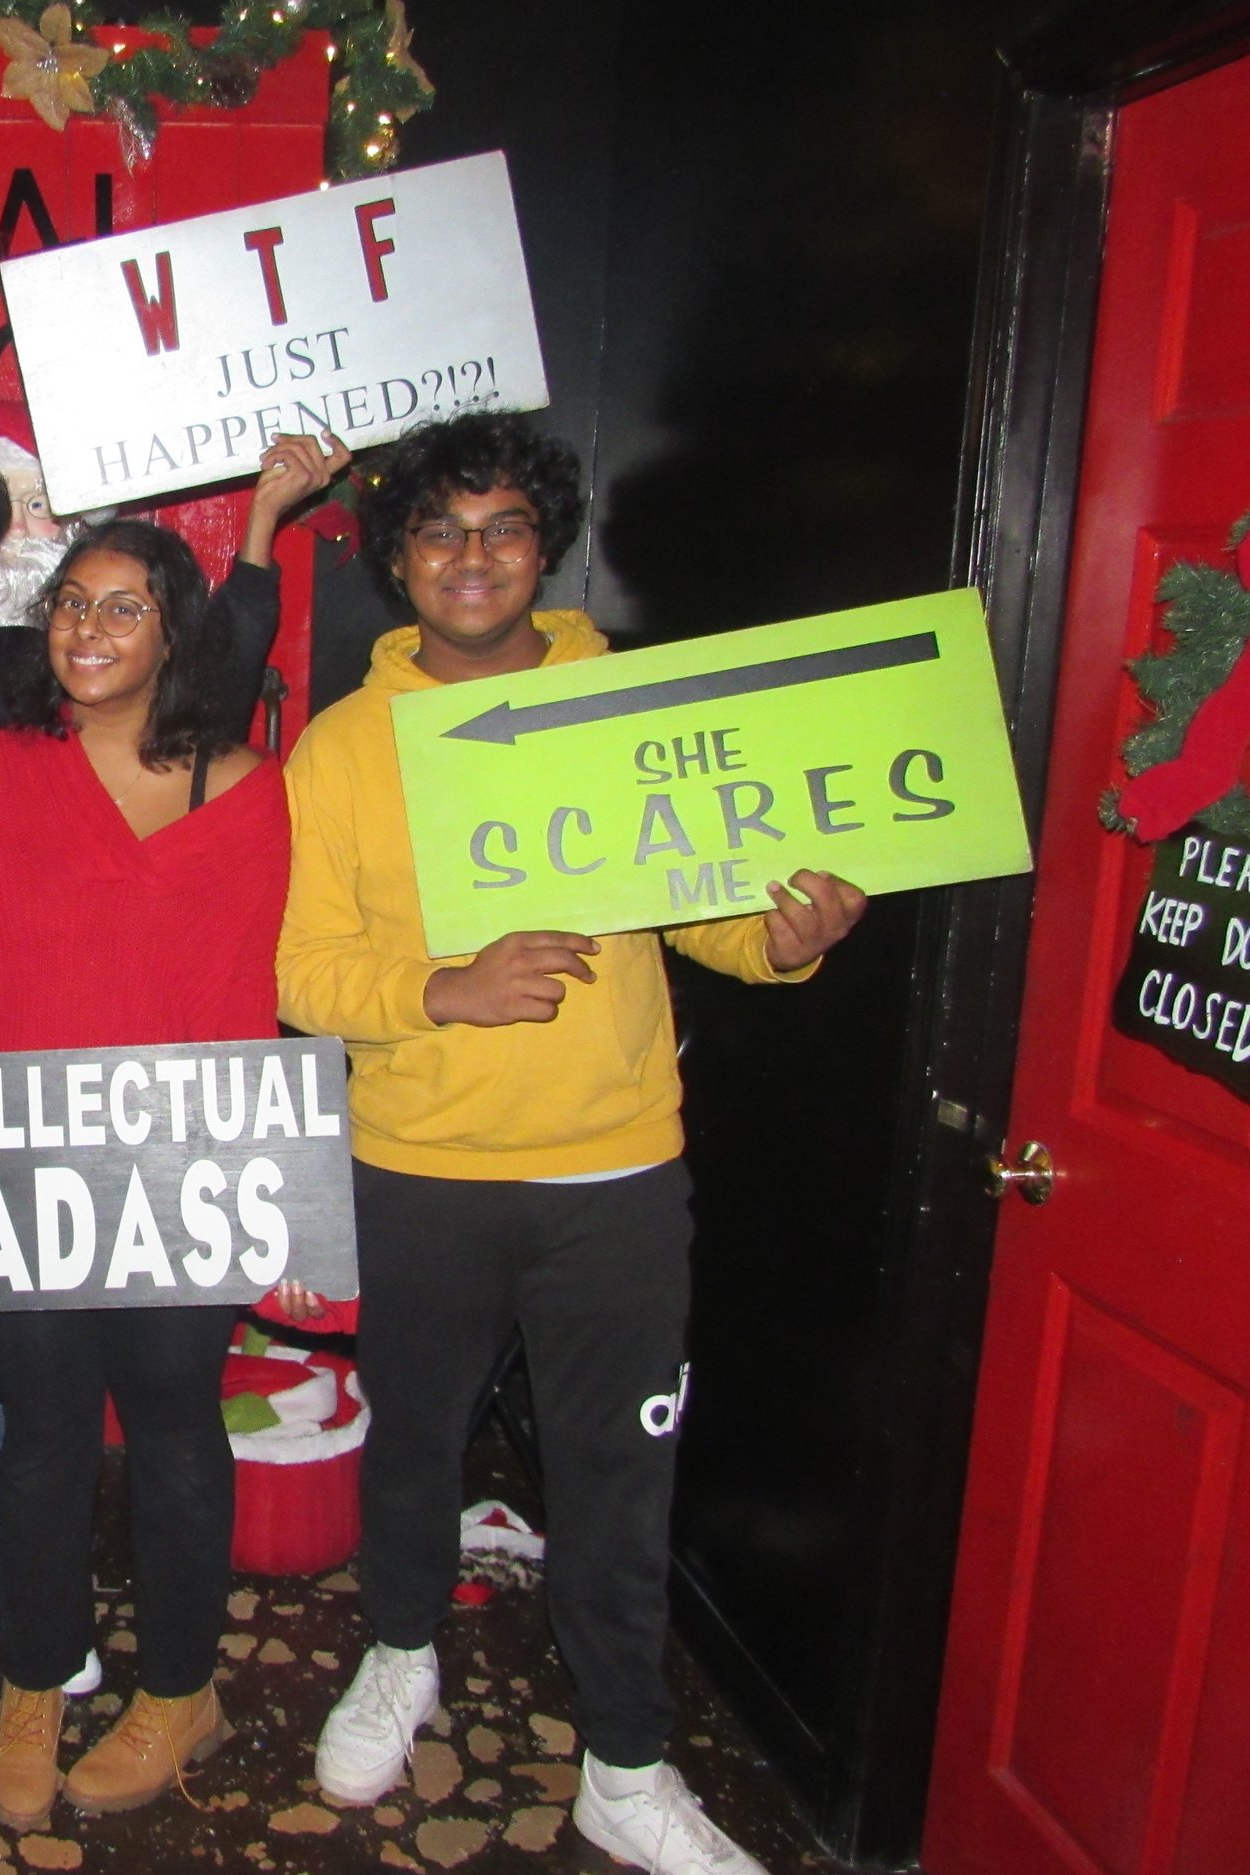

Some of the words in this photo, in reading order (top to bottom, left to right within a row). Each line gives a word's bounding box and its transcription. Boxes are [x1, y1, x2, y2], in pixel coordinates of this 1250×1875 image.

[216, 327, 350, 398] JUST
[633, 727, 748, 786] SHE
[468, 748, 956, 890] SCARES
[665, 858, 756, 911] ME
[1139, 890, 1203, 947] KEEP
